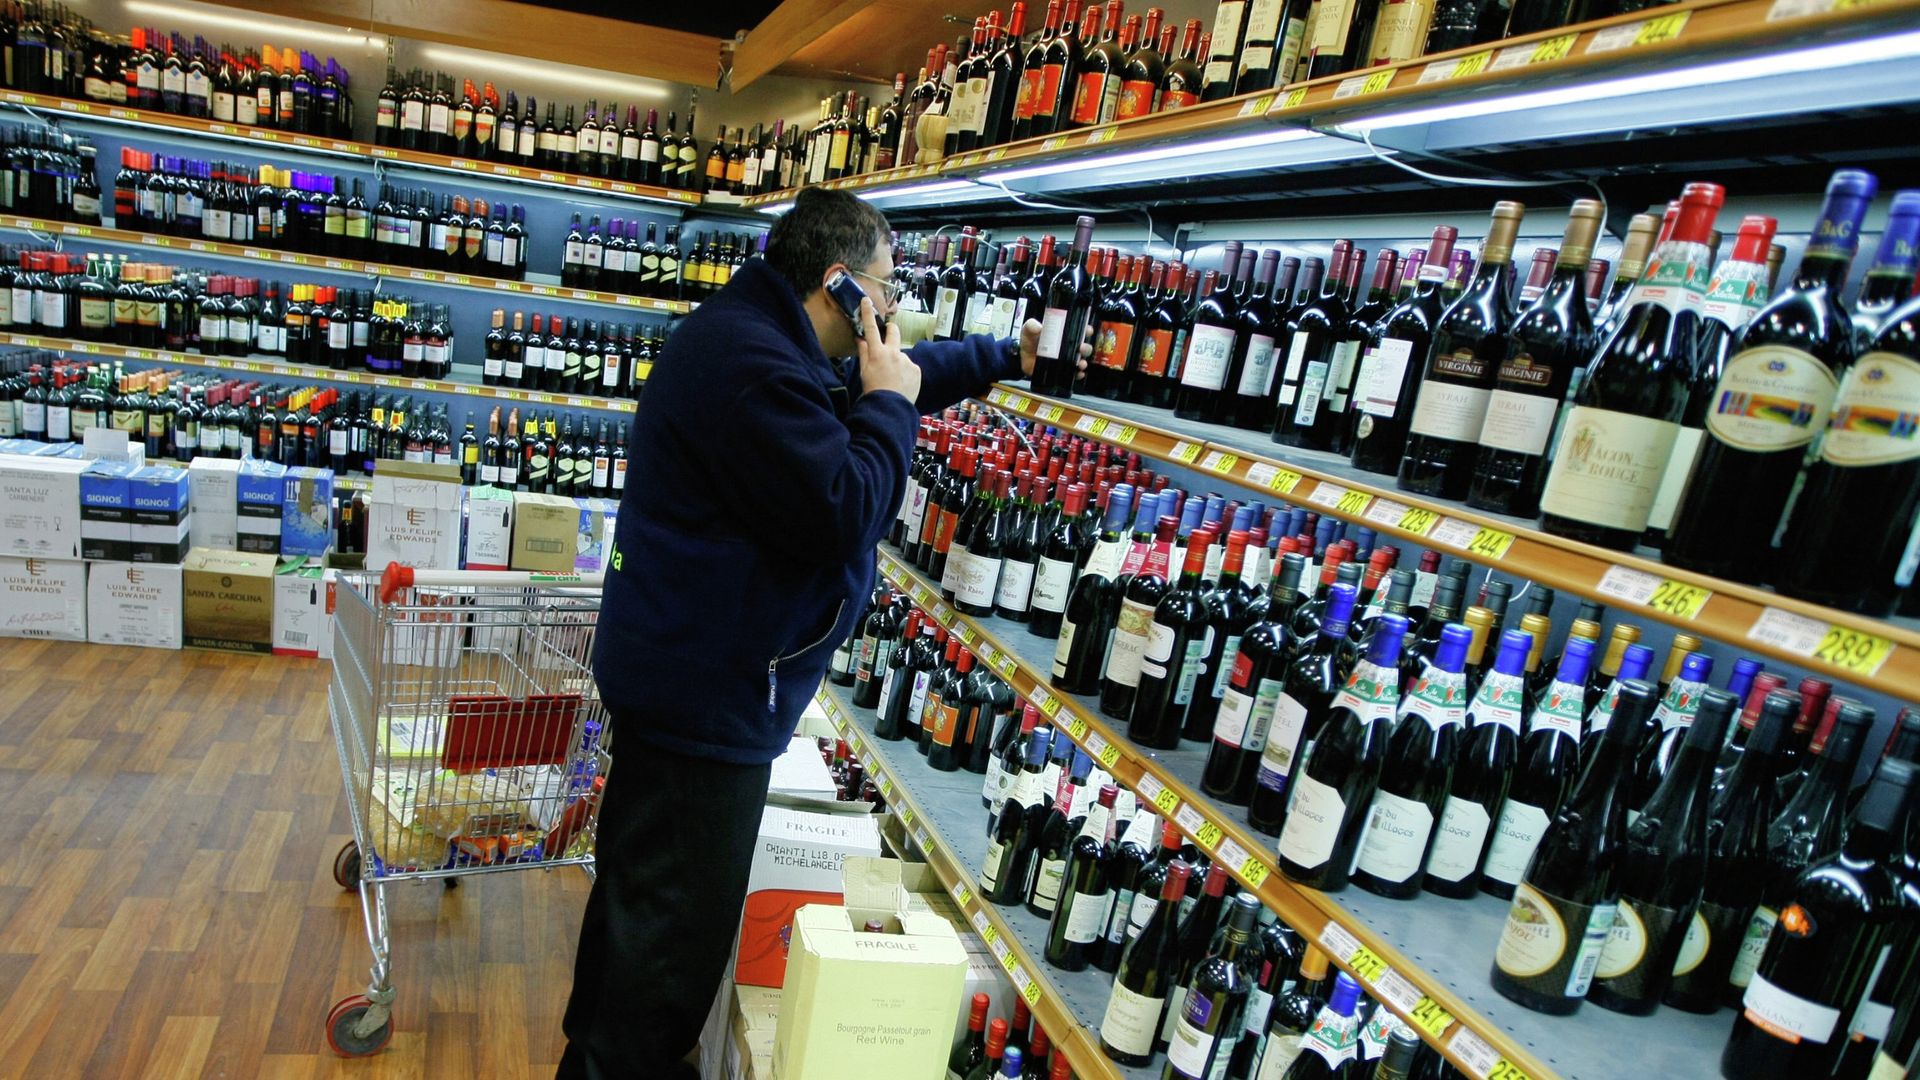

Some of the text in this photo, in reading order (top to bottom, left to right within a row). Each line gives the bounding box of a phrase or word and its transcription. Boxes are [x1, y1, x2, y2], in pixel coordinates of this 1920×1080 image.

[1529, 35, 1568, 63] 229
[1452, 55, 1484, 78] 220
[1362, 73, 1388, 95] 197
[1438, 358, 1482, 376] VIRGINIE
[86, 494, 122, 504] SIGNOS
[134, 498, 170, 508] SIGNOS
[243, 492, 275, 502] SIGNOS
[1336, 490, 1365, 516] 220
[1398, 507, 1430, 532] 229
[384, 526, 443, 537] LUIS FELIPE
[389, 535, 438, 545] EDWARDS
[1468, 528, 1506, 556] 244
[3, 577, 68, 588] LUIS FELIPE
[9, 586, 63, 594] EDWARDS
[106, 583, 164, 594] LUIS FELIPE
[111, 591, 159, 601] EDWARDS
[187, 589, 263, 604] SANTA CAROLINA
[1649, 580, 1697, 616] 246
[192, 639, 218, 648] SANTA
[1814, 629, 1874, 667] 289
[786, 820, 850, 839] FRAGILE
[1195, 820, 1217, 849] 206
[765, 842, 806, 857] CHIANTI
[1240, 857, 1264, 883] 196
[855, 940, 920, 952] FRAGILE
[1348, 948, 1379, 980] 227
[1411, 995, 1446, 1033] 247
[836, 1022, 877, 1036] Bourgogne
[912, 1026, 932, 1038] grain
[856, 1035, 905, 1046] Red Wine
